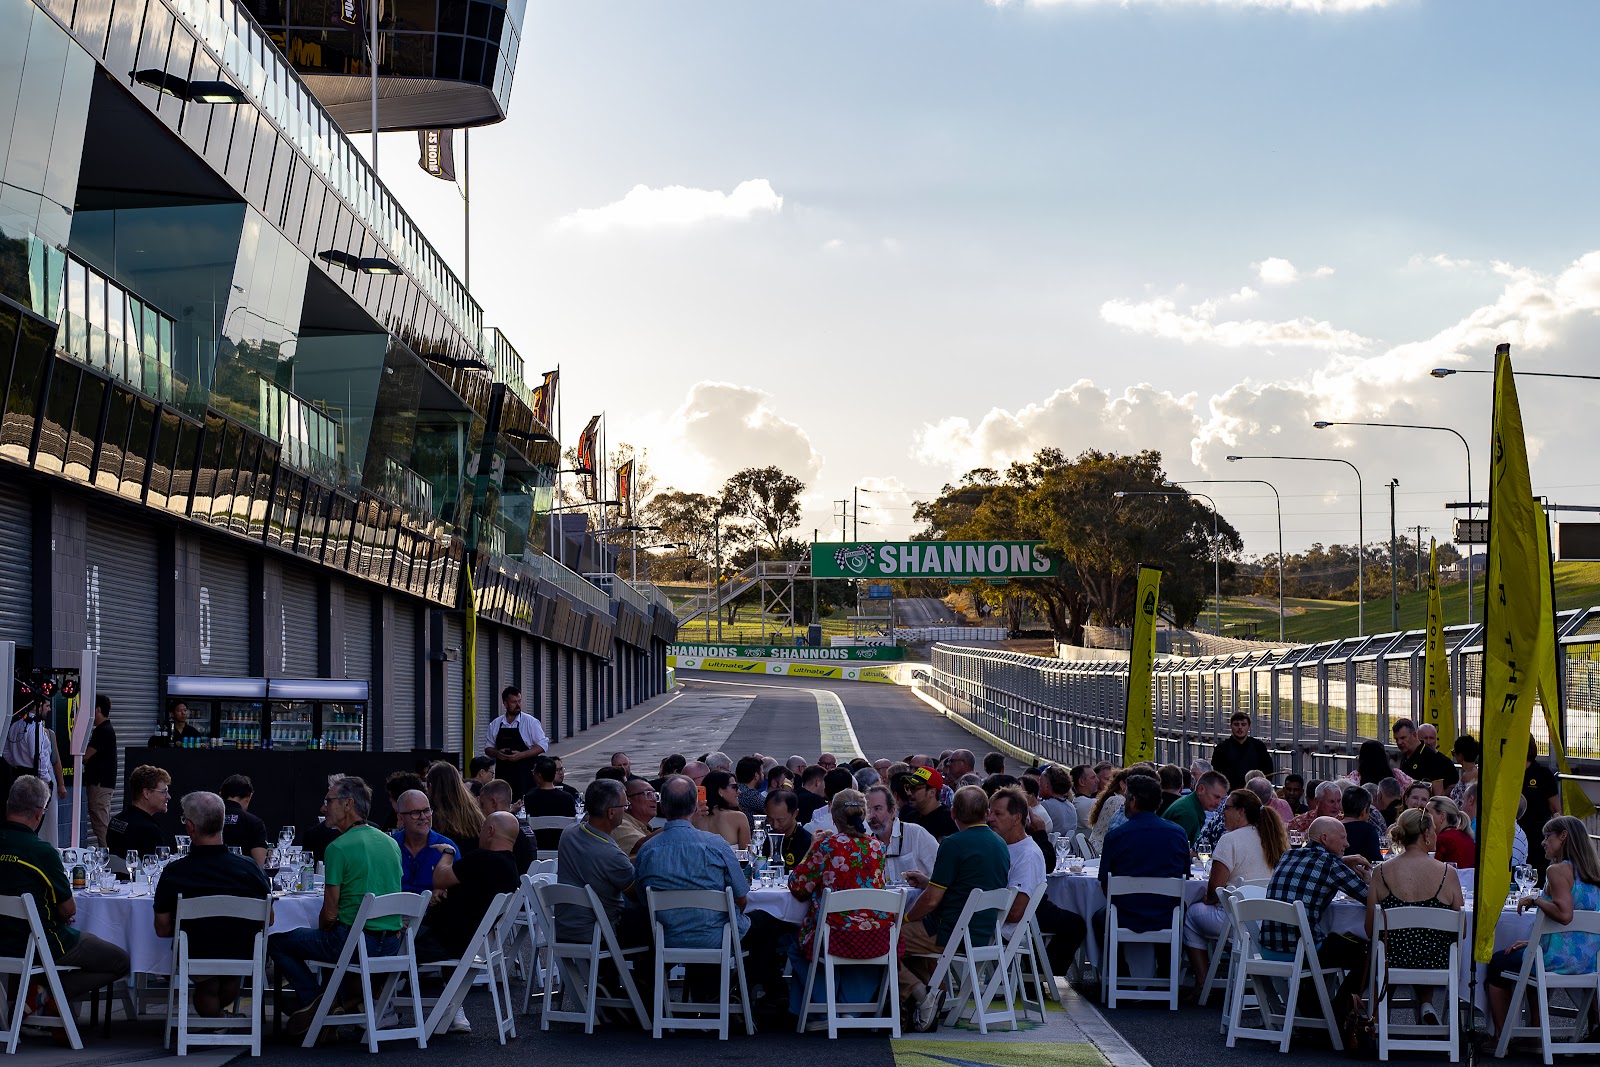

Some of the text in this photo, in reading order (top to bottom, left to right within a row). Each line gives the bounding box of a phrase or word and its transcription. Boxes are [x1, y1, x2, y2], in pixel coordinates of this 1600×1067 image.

[879, 545, 1051, 573] SHANNONS
[665, 645, 738, 658] SHANNONS
[771, 648, 849, 660] SHANNONS
[0, 853, 18, 863] OTUS
